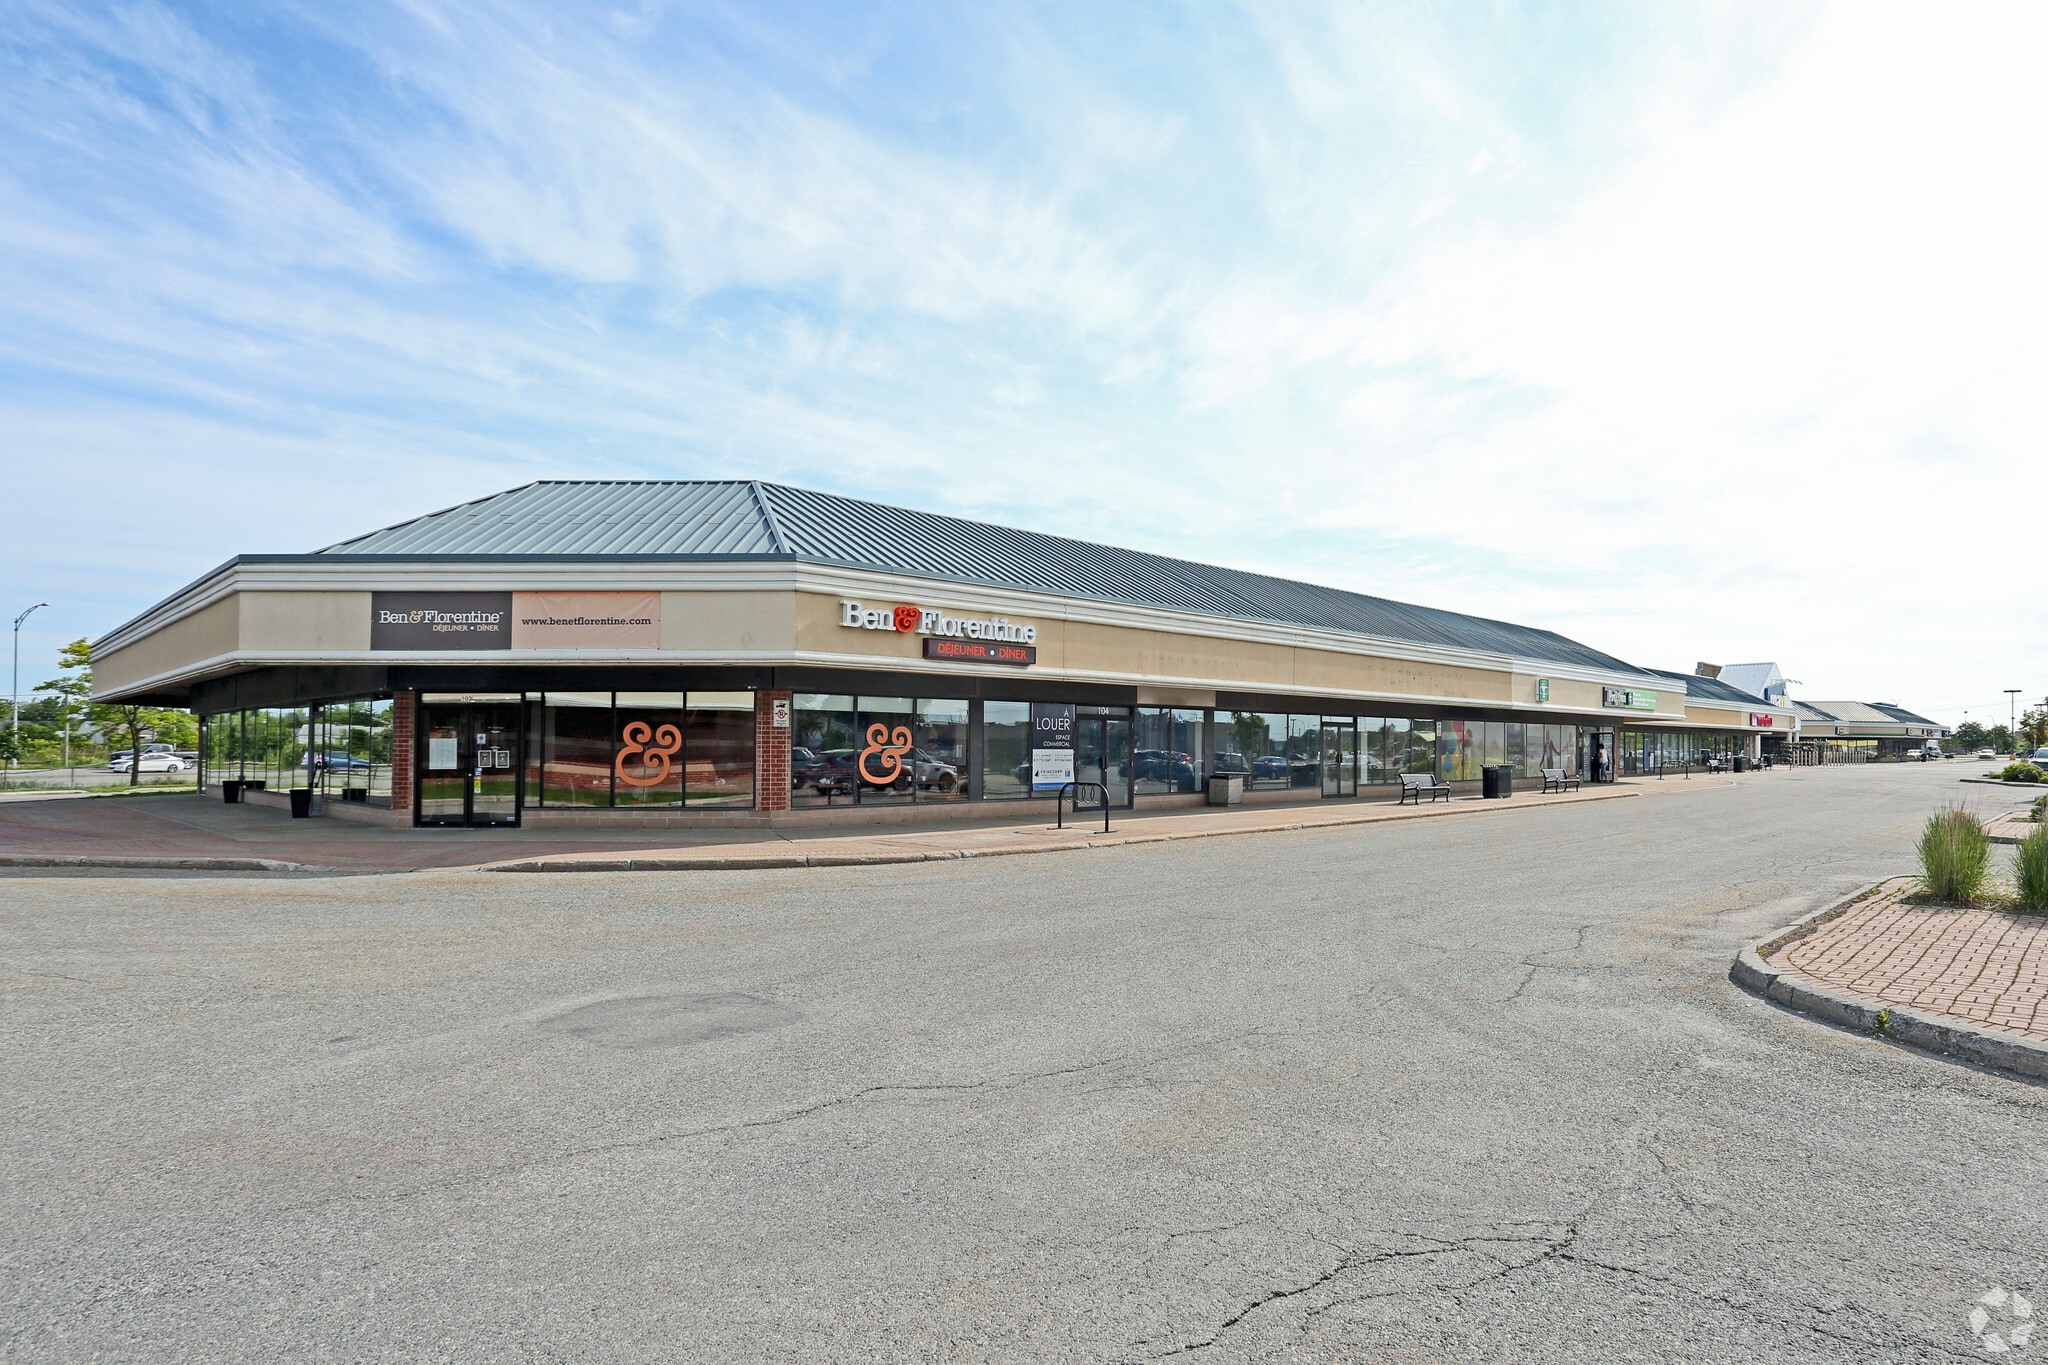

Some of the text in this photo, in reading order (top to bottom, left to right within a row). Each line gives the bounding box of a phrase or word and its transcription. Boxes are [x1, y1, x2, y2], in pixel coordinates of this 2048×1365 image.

[521, 617, 652, 626] www.benetflorentine.com
[432, 624, 499, 632] DÉJEUNER DÎNER
[937, 642, 1027, 660] DÉJEUNER DÎNER
[1098, 706, 1109, 715] 104
[1036, 717, 1071, 731] LOUER
